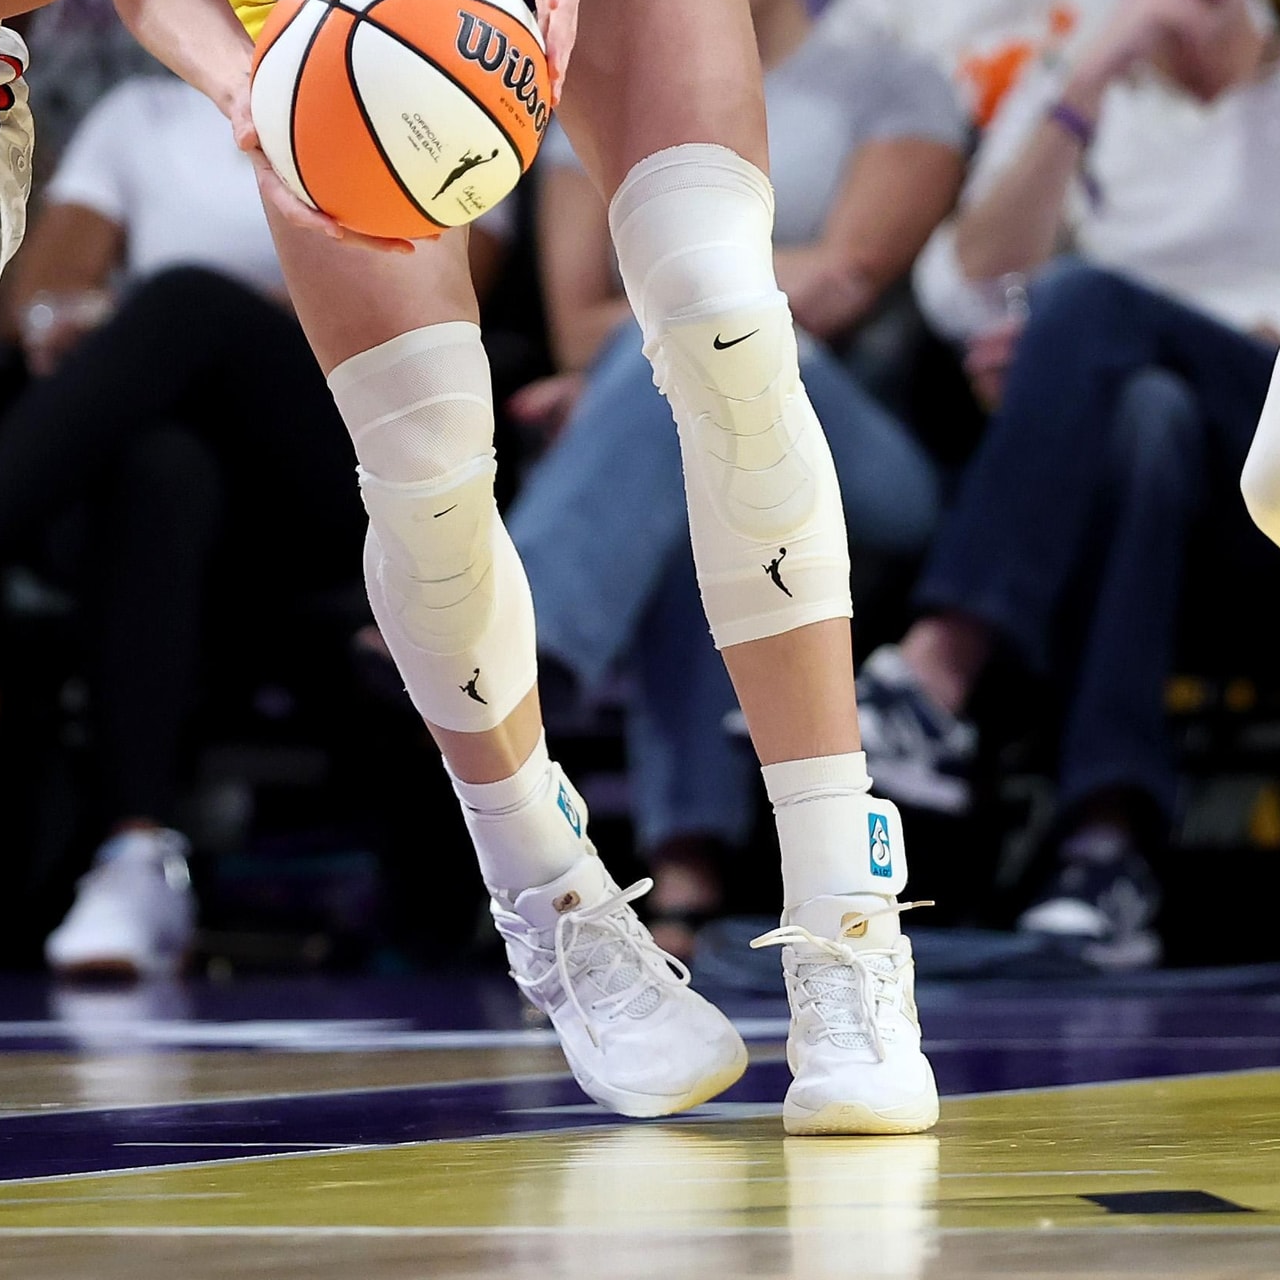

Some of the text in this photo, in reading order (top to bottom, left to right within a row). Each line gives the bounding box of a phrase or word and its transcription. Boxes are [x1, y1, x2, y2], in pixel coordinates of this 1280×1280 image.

[455, 8, 549, 144] Wilso
[401, 112, 425, 141] GAME
[422, 140, 440, 164] BALL
[413, 113, 442, 153] OFFICIAL
